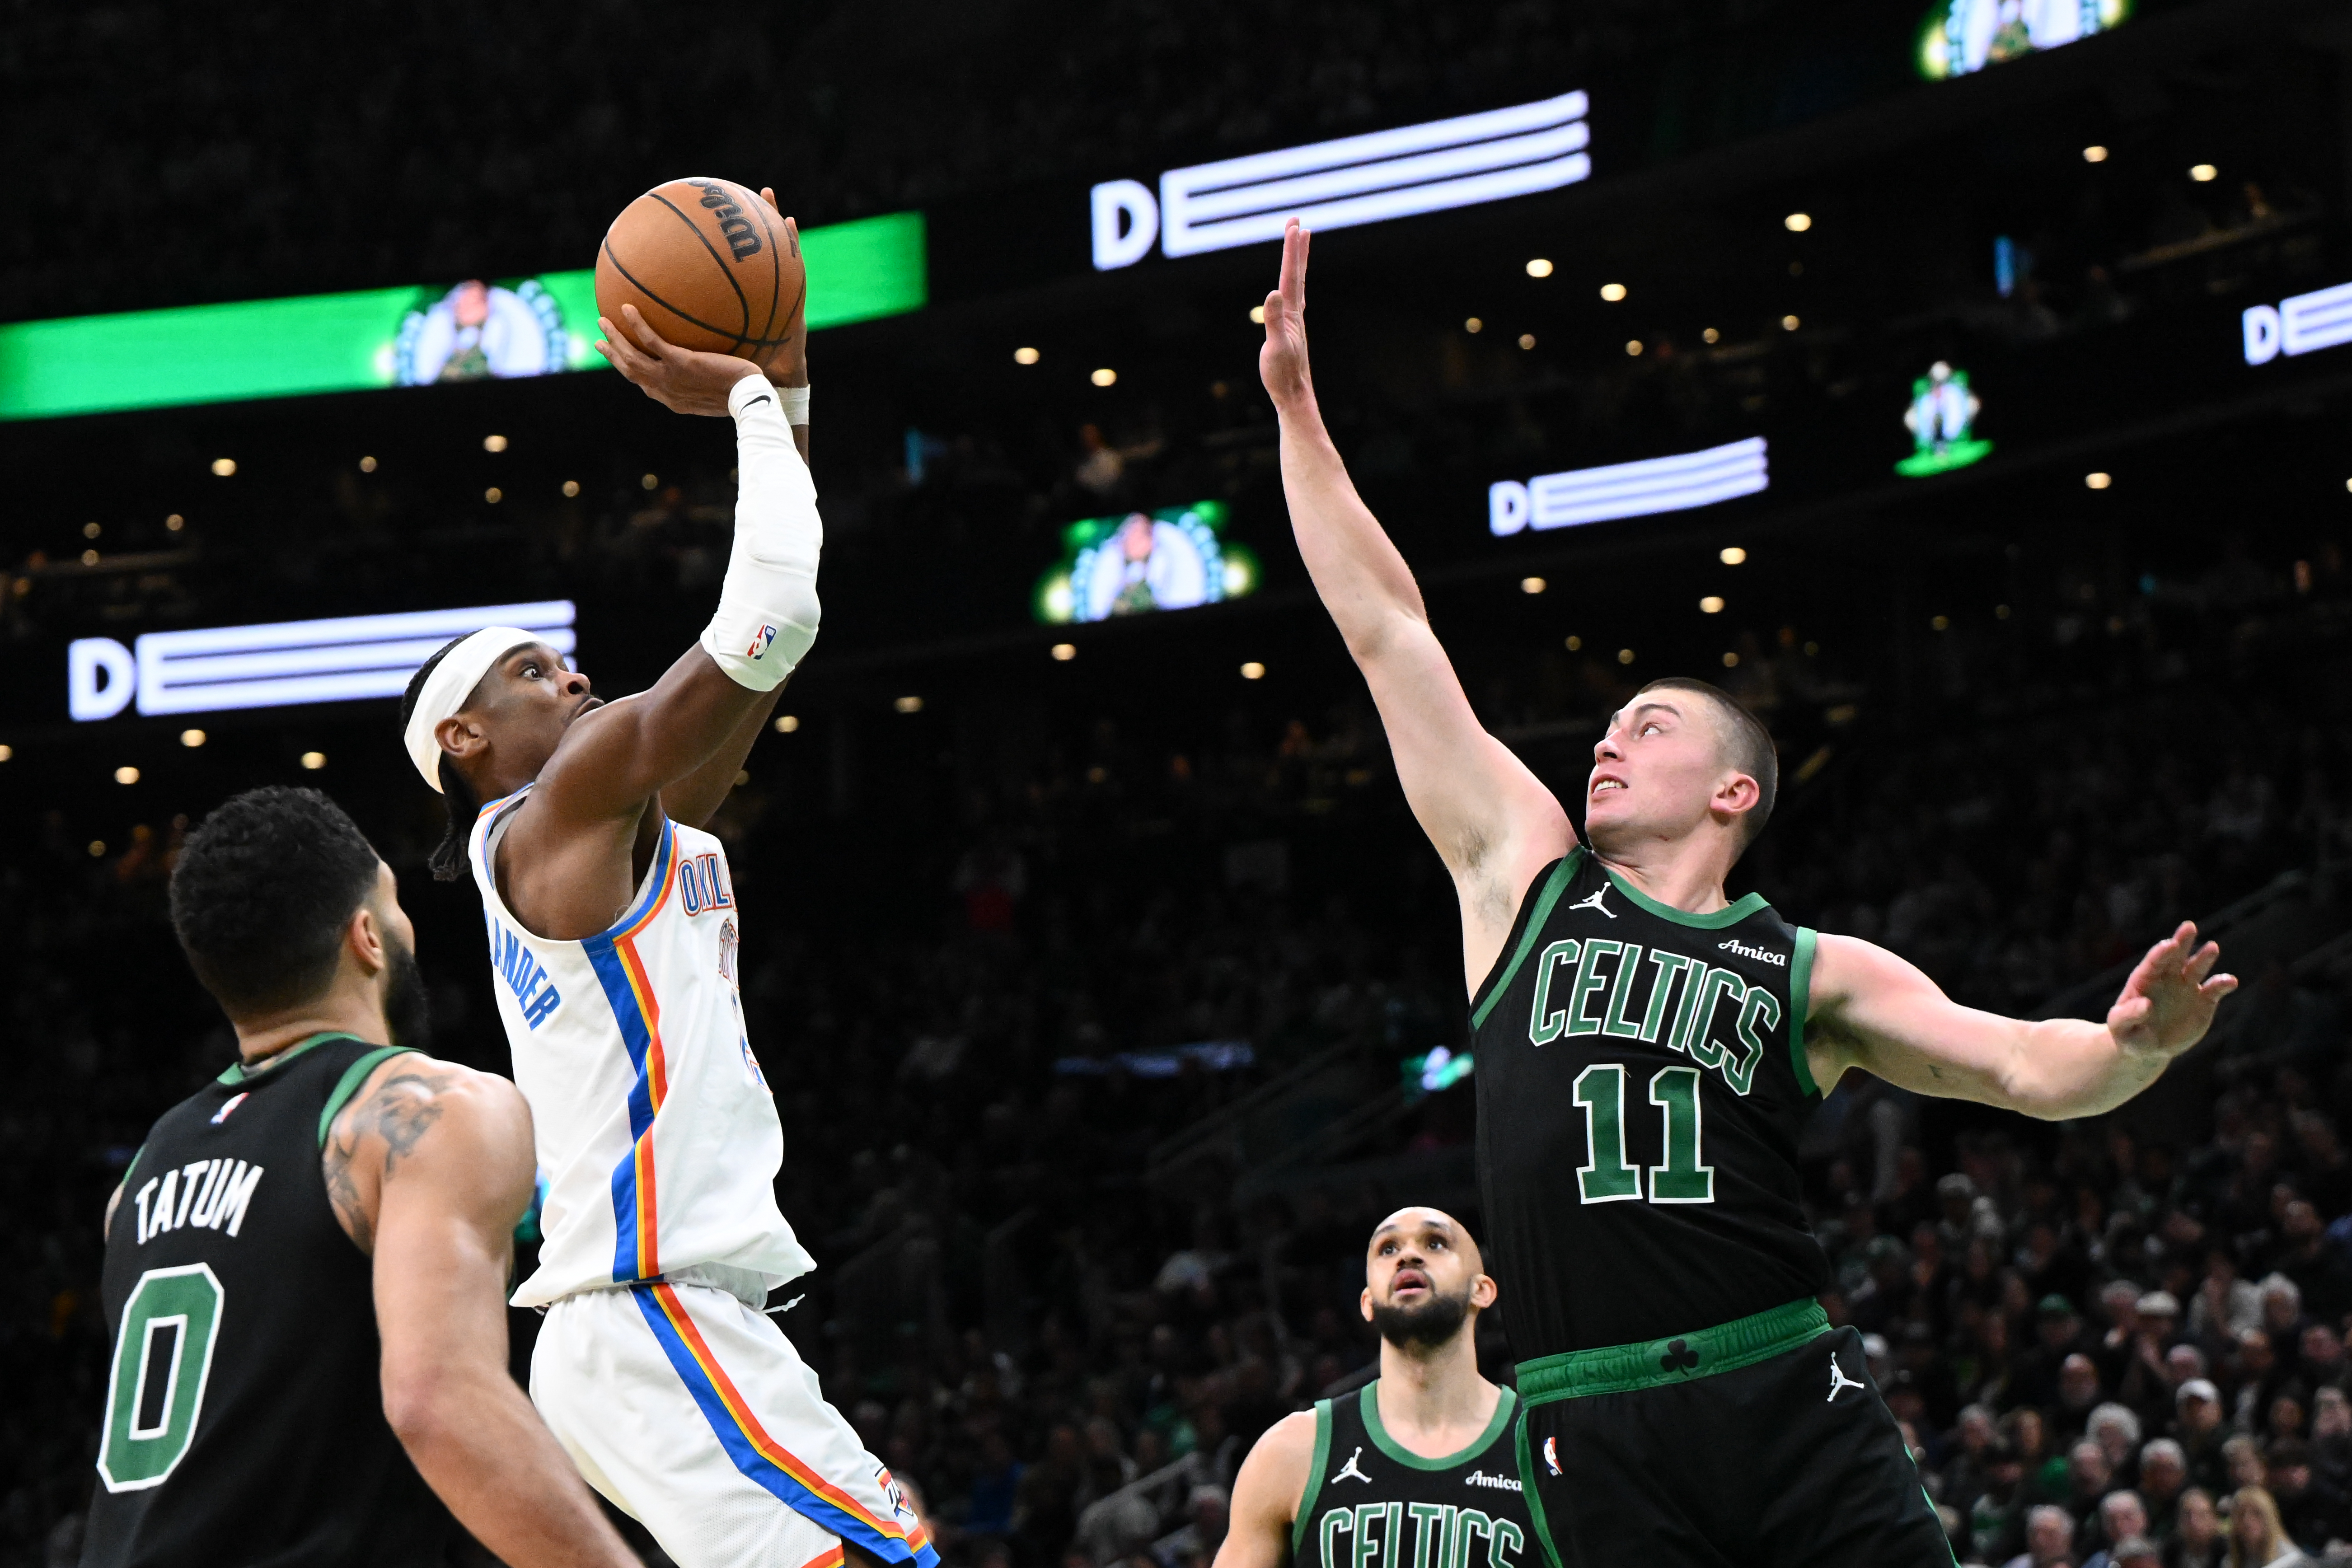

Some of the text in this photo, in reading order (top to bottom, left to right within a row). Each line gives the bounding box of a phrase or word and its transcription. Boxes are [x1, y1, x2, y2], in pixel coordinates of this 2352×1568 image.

[678, 853, 738, 919] OKL
[484, 909, 561, 1031] ANDER
[1718, 939, 1785, 966] Amica
[1529, 938, 1780, 1096] CELTICS
[1573, 1063, 1715, 1204] 11
[135, 1158, 264, 1245] TATUM
[97, 1263, 224, 1493] 0
[1465, 1470, 1522, 1492] Amica
